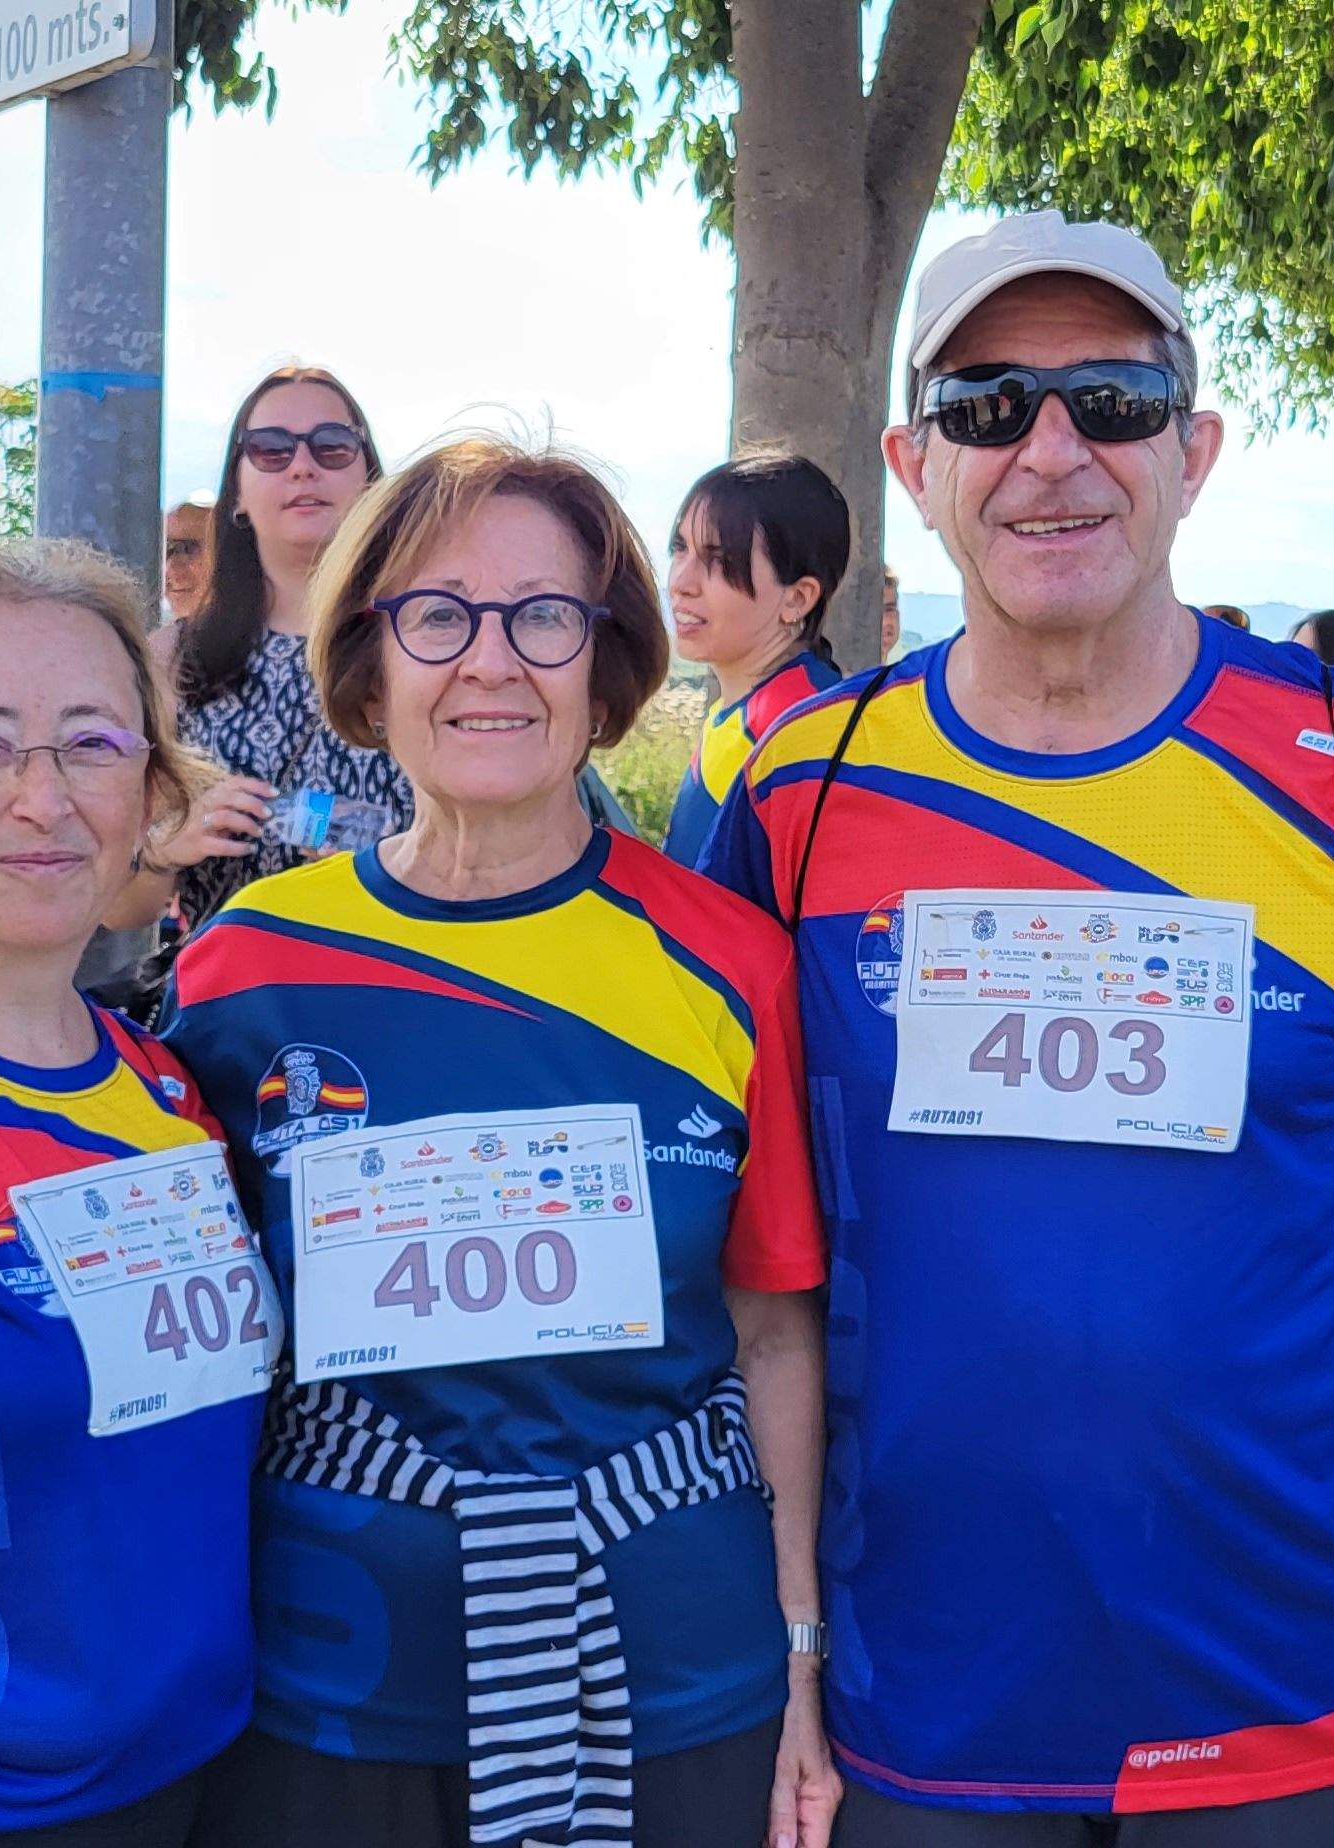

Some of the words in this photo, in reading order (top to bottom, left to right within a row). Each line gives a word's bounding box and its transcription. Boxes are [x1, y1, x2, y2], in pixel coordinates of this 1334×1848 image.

[47, 1, 111, 66] mts.
[1012, 930, 1065, 942] Santander
[860, 963, 900, 979] RUT
[969, 1012, 1167, 1096] 403
[909, 1108, 983, 1127] #RUTA091
[1116, 1118, 1207, 1138] POLICIA
[1170, 1133, 1227, 1145] NACIONAL
[400, 1155, 454, 1169] Santander
[643, 1140, 737, 1174] Santander
[374, 1229, 578, 1318] 400
[143, 1265, 269, 1362] 402
[537, 1322, 626, 1341] POLICIA
[315, 1344, 398, 1370] #RUTA091
[109, 1391, 168, 1424] #RUTA091
[1128, 1742, 1222, 1769] @policia
